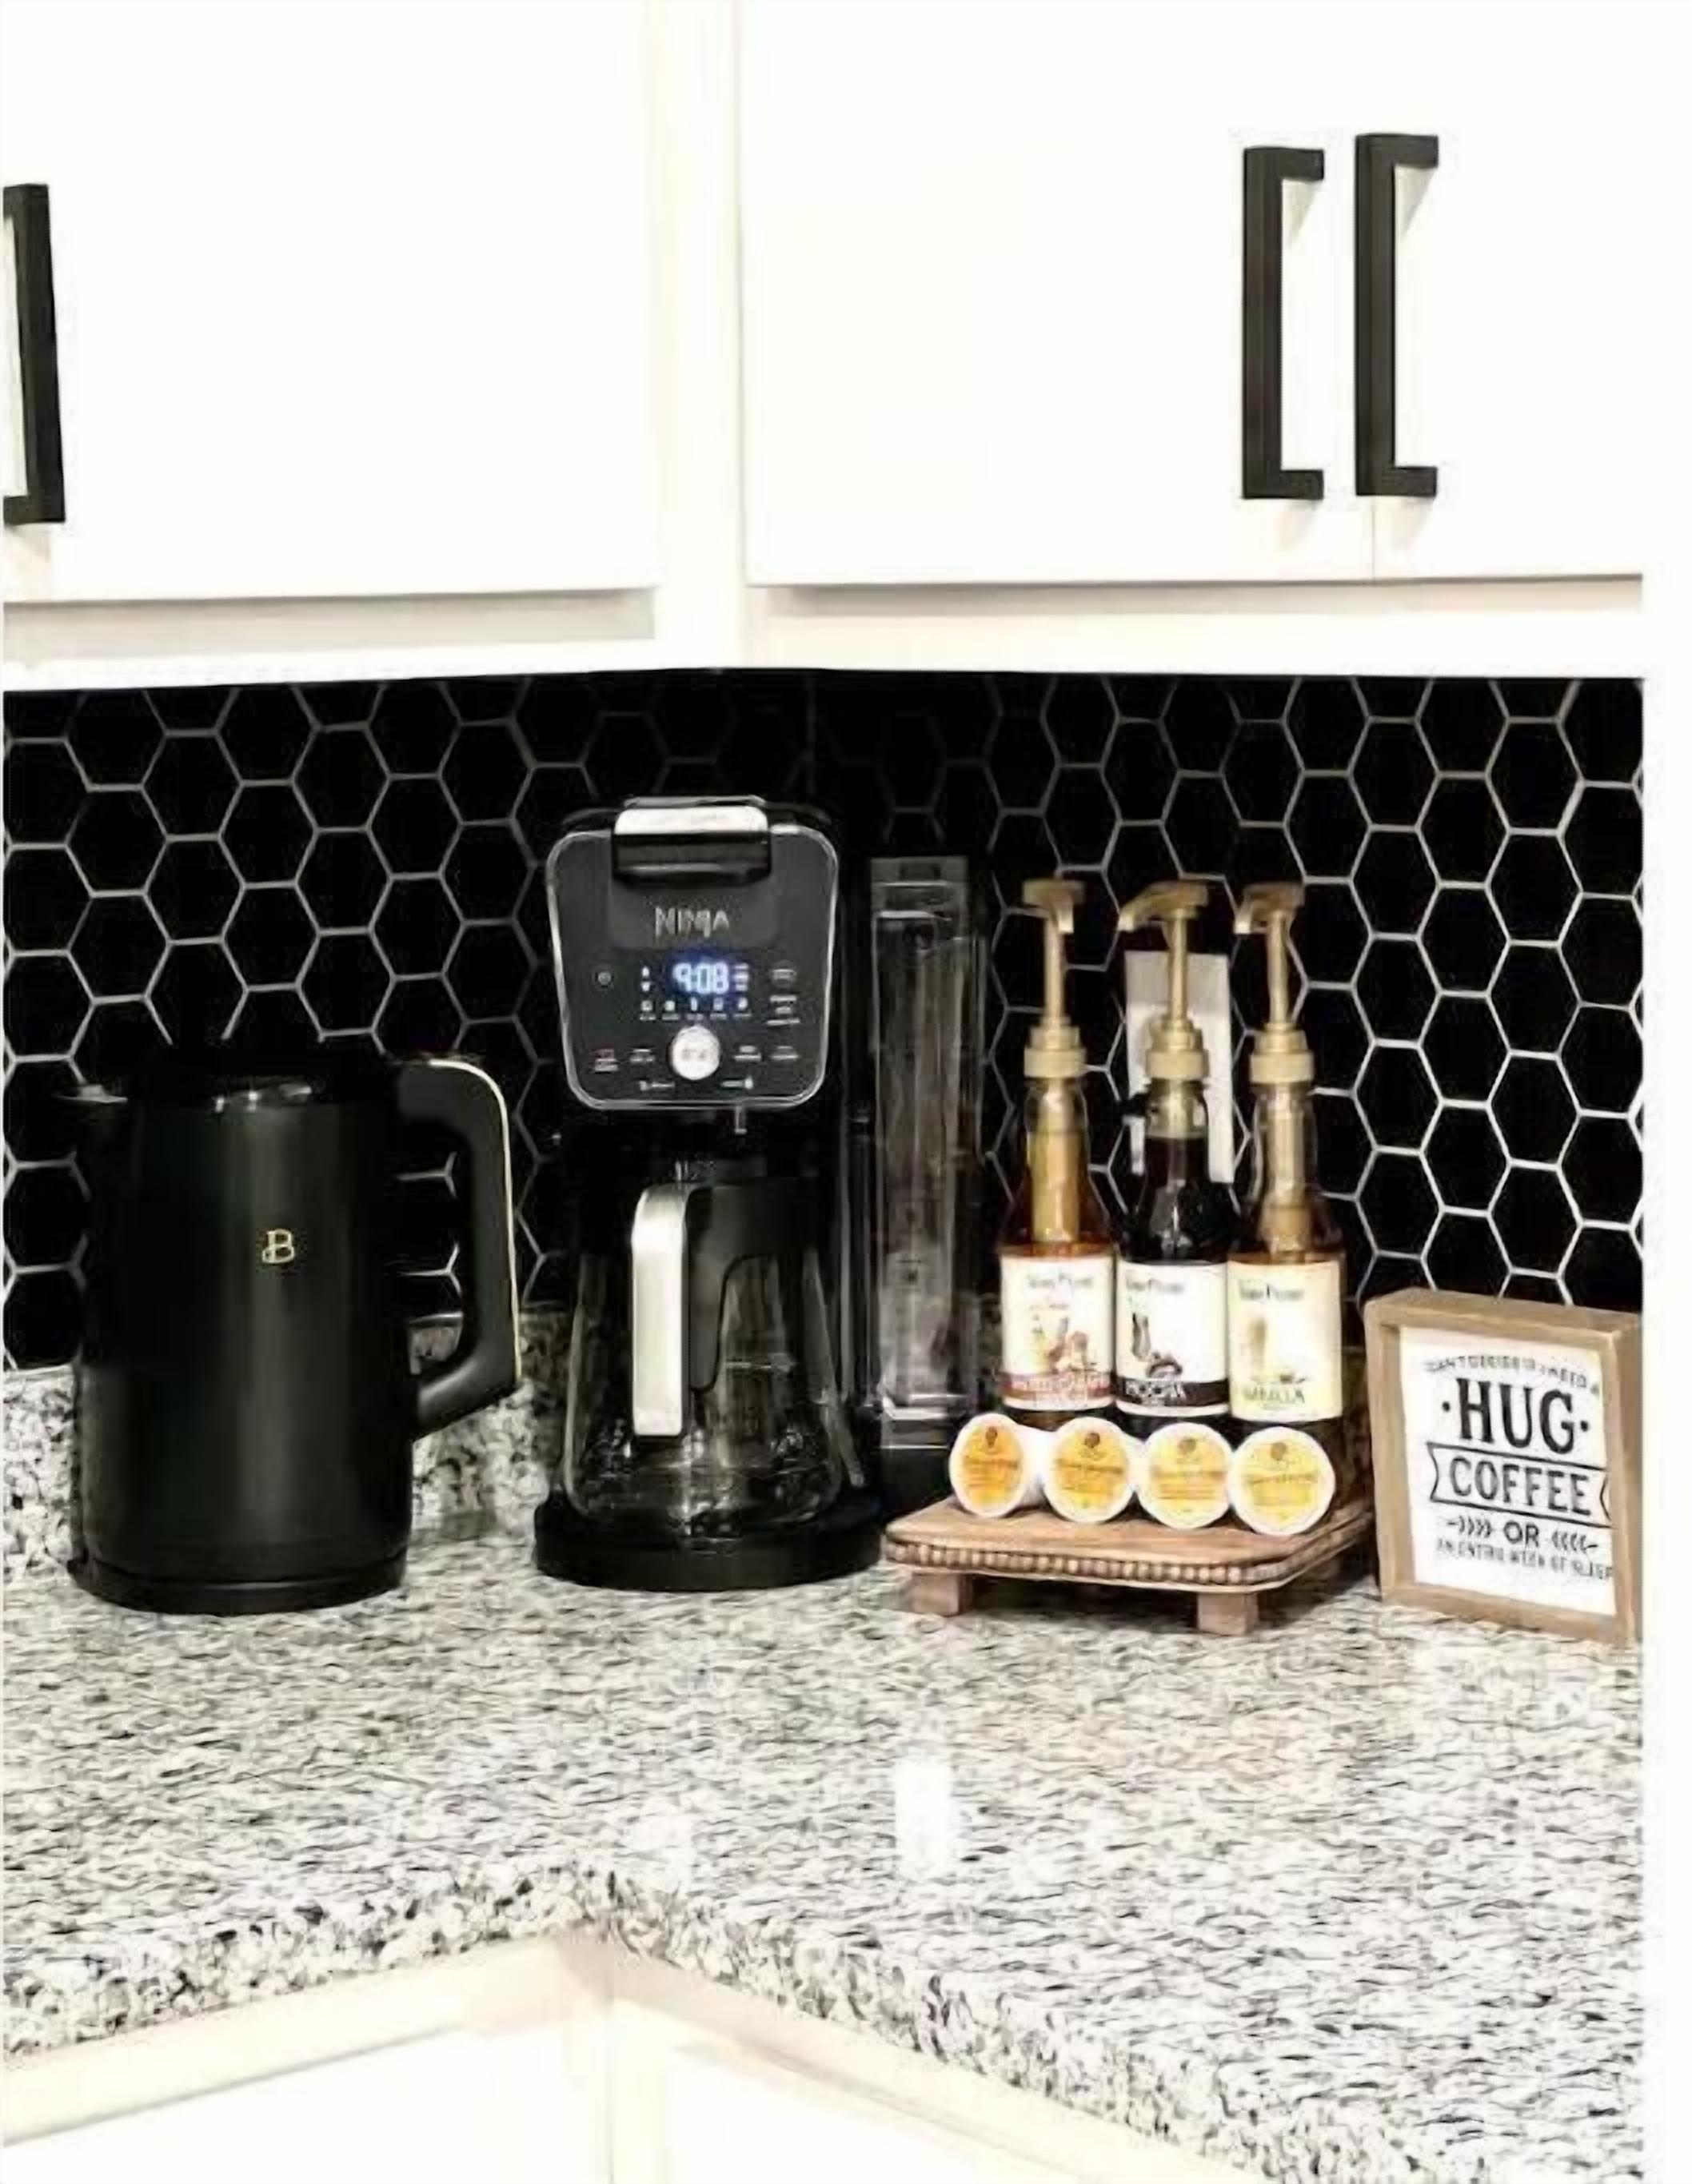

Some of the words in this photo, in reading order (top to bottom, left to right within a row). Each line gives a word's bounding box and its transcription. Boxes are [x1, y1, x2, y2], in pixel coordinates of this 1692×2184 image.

[655, 907, 729, 938] NINJA
[262, 1229, 295, 1263] B
[1455, 1378, 1575, 1454] HUG
[1450, 1457, 1592, 1516] COFFEE
[1503, 1520, 1540, 1548] OR
